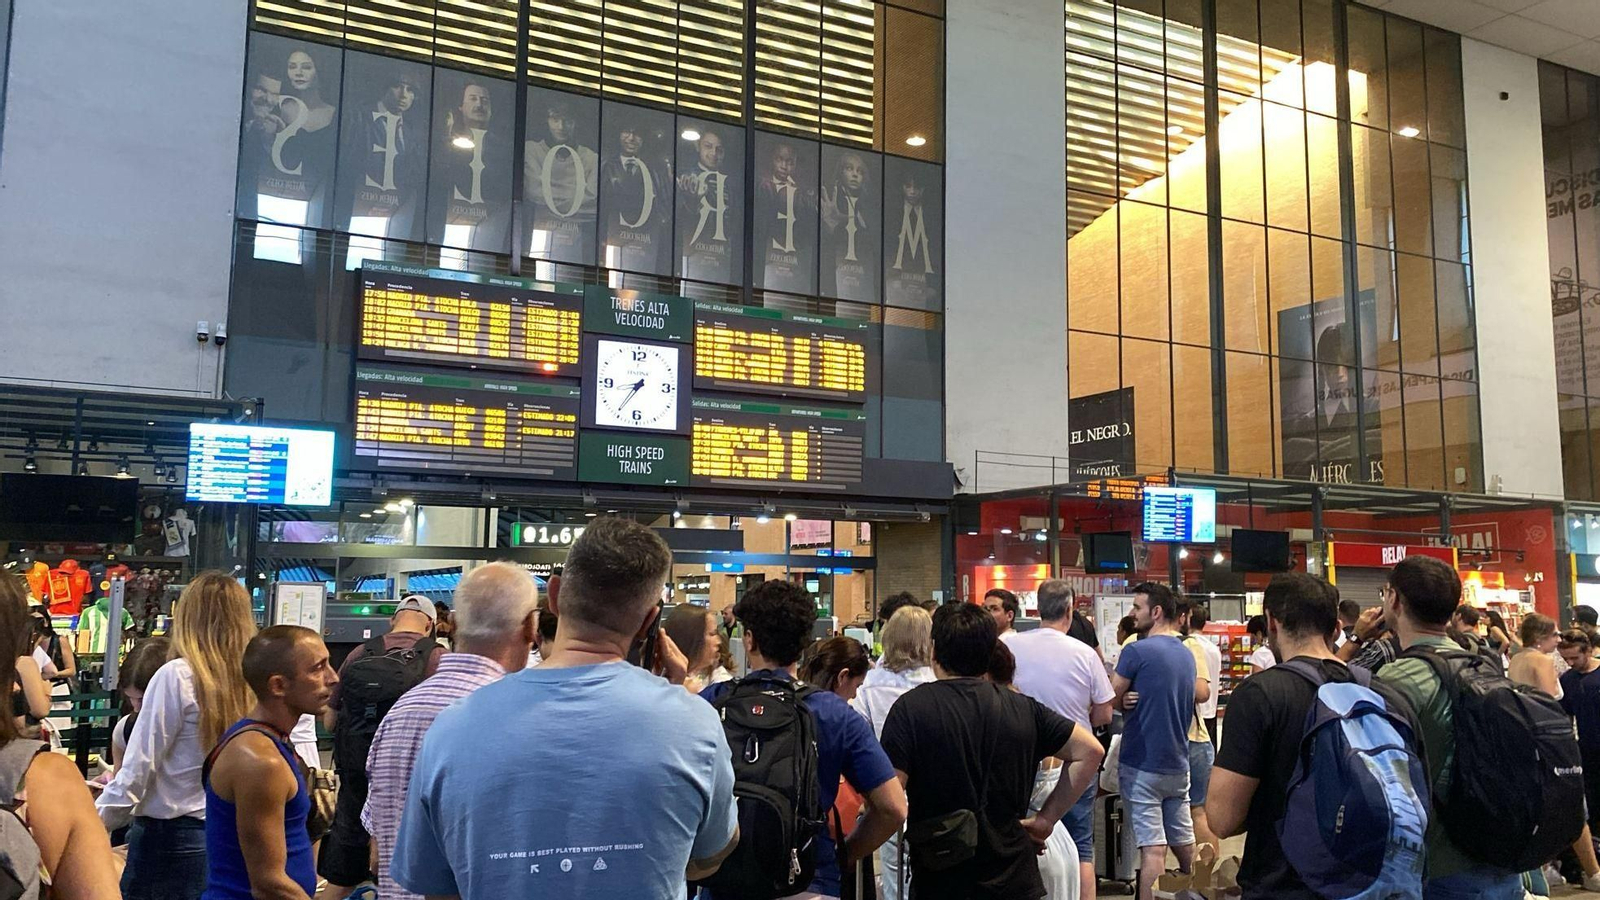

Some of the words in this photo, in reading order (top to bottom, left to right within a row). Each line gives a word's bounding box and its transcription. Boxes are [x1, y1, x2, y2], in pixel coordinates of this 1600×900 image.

[364, 261, 389, 273] Llegadas:
[390, 265, 403, 273] Alta
[403, 266, 429, 276] velocidad
[611, 296, 645, 313] TRENES
[648, 301, 670, 316] ALTA
[722, 305, 743, 314] velocidad
[615, 312, 665, 330] VELOCIDAD
[632, 351, 647, 362] 12
[357, 371, 383, 383] Llegadas:
[384, 375, 396, 383] Alta
[396, 375, 423, 384] velocidad
[604, 378, 614, 388] 9
[662, 383, 670, 394] 3
[692, 400, 709, 408] Salidas:
[720, 402, 741, 410] velocidad
[524, 412, 553, 420] ESTIMADO
[633, 410, 641, 420] 6
[523, 427, 553, 436] ESTIMADO
[607, 445, 633, 459] HIGH
[635, 447, 664, 460] SPEED
[619, 460, 652, 475] TRAINS
[1382, 546, 1407, 565] RELAY
[583, 845, 612, 853] WITHOUT
